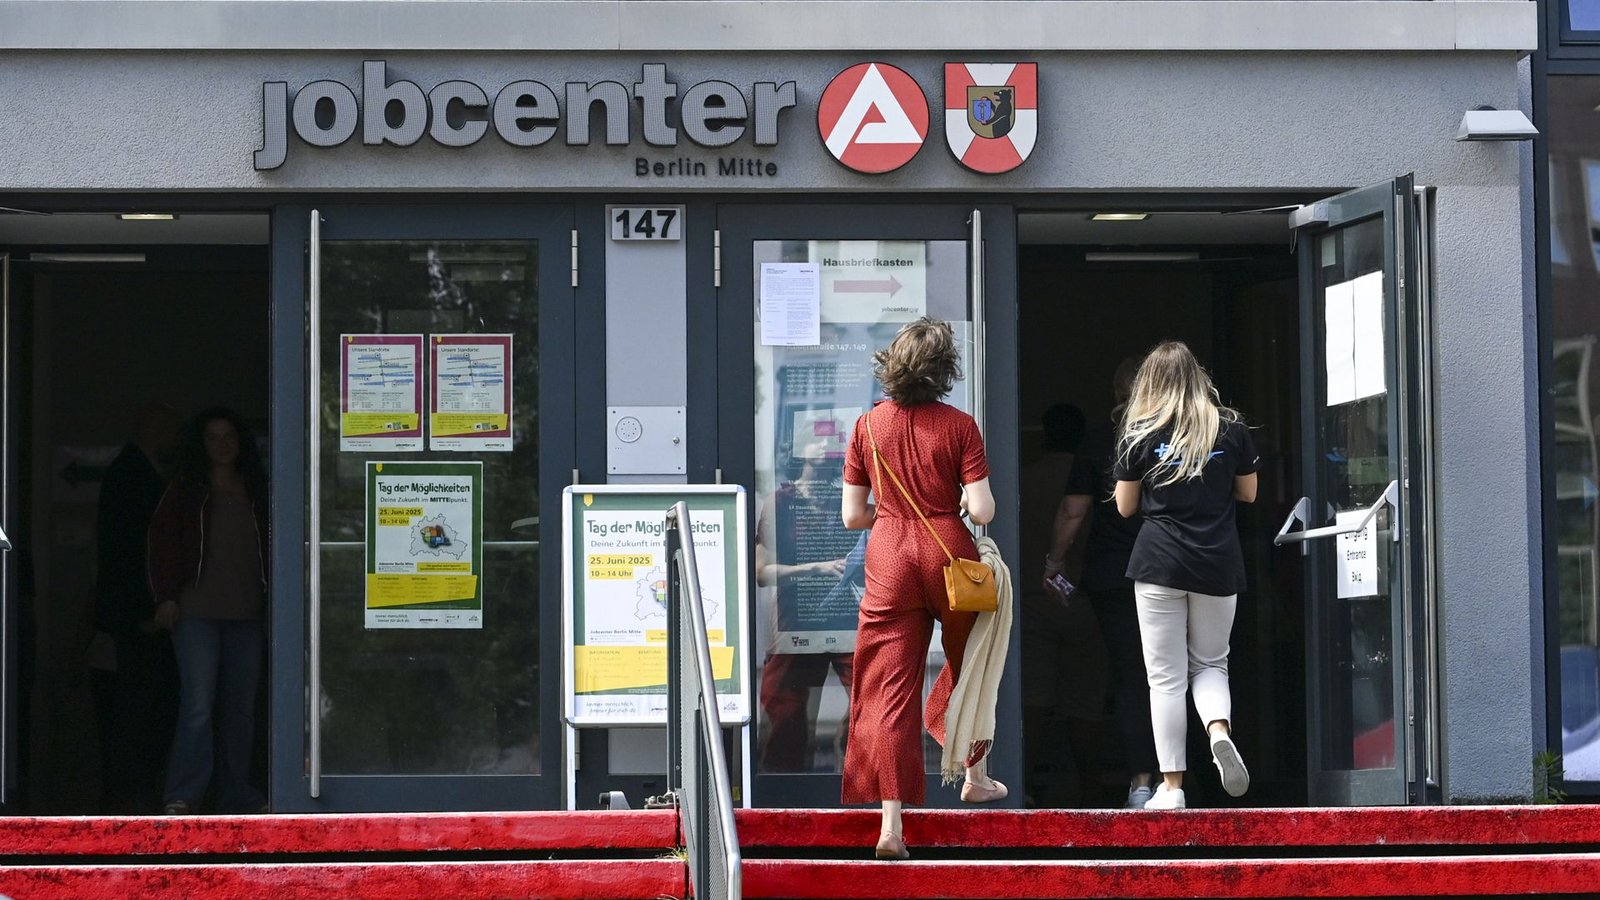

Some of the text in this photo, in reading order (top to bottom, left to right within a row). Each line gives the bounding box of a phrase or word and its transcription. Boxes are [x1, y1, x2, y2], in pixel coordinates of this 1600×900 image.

[254, 60, 797, 171] jobcenter
[635, 158, 778, 176] Berlin Mitte
[615, 209, 677, 239] 147
[823, 258, 914, 268] Hausbriefkasten
[378, 482, 471, 495] Tag der Möglichkeiten
[587, 519, 721, 537] Tag der Mögleiten
[590, 539, 614, 548] Deine
[616, 539, 648, 548] Zukunft
[650, 539, 661, 548] im
[590, 556, 650, 565] 25. Juni 2025
[1347, 549, 1367, 560] Entrance
